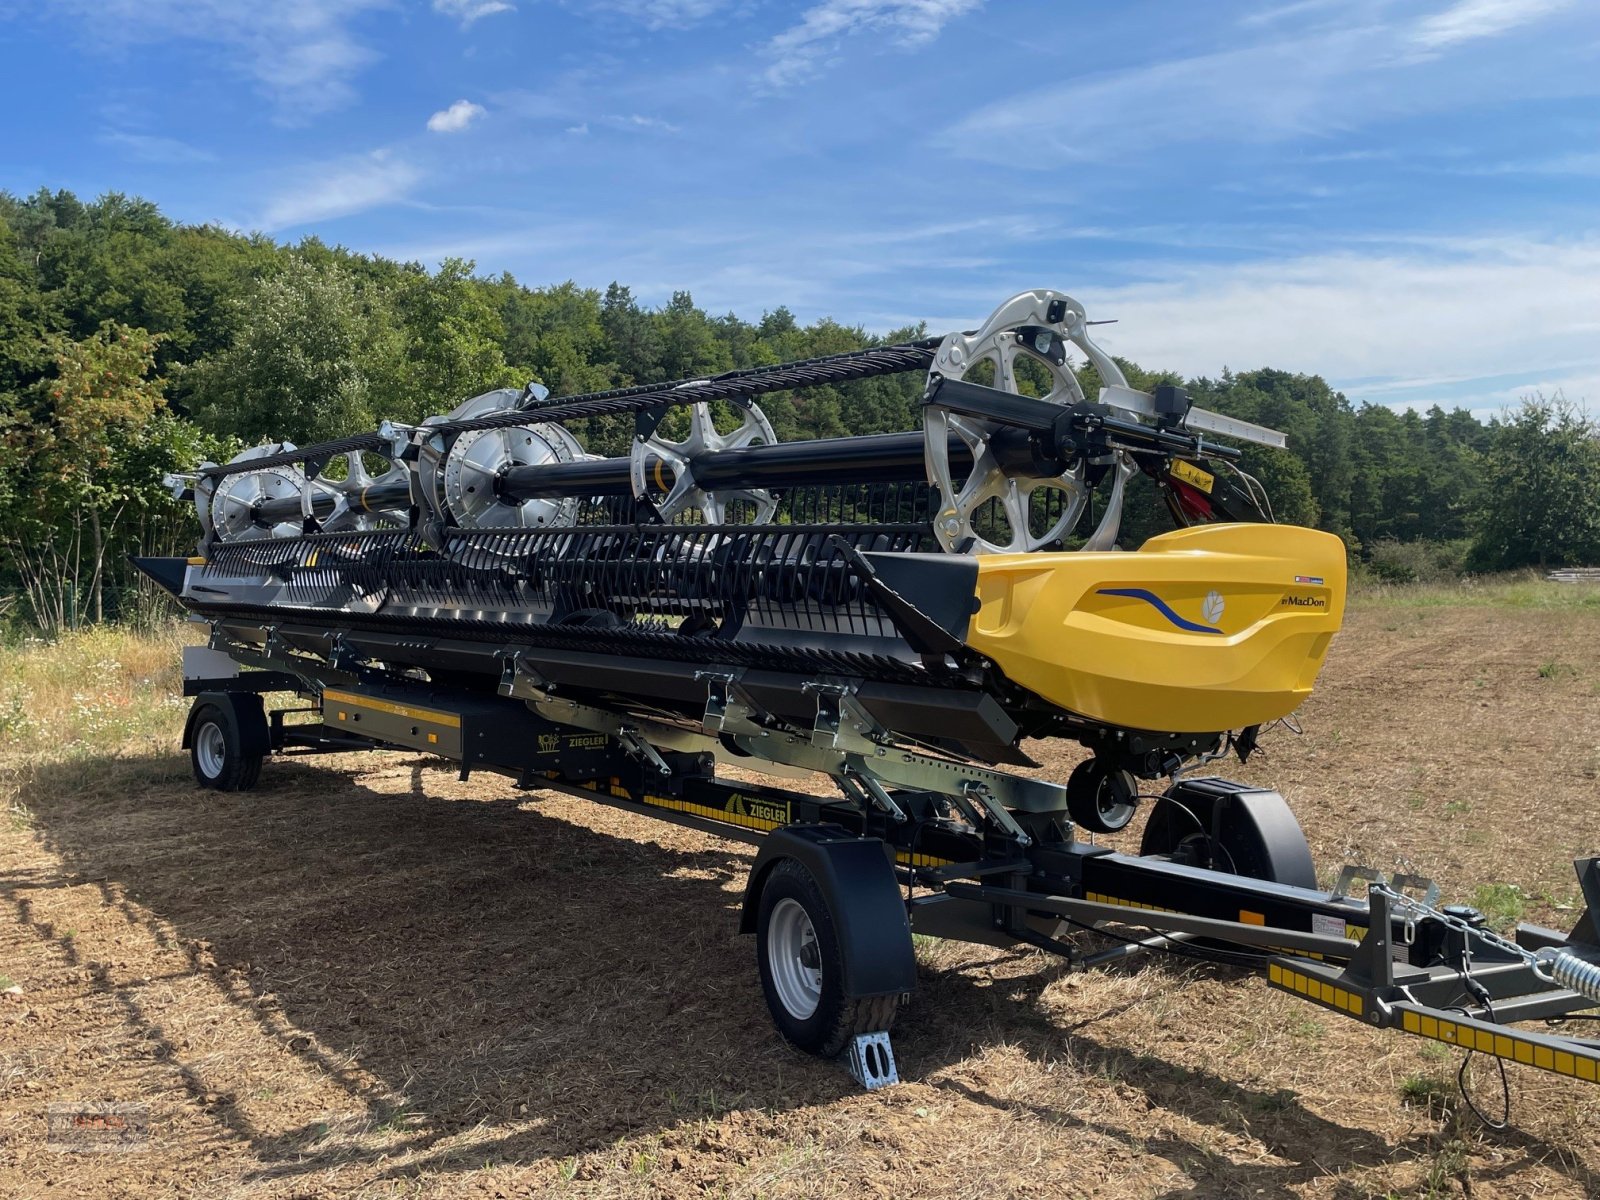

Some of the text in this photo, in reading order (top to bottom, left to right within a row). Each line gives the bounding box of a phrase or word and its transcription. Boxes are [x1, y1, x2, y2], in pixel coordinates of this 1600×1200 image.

[1288, 596, 1325, 606] MacDon
[569, 736, 604, 747] ZIEGLER
[750, 804, 786, 823] ZIEGLER
